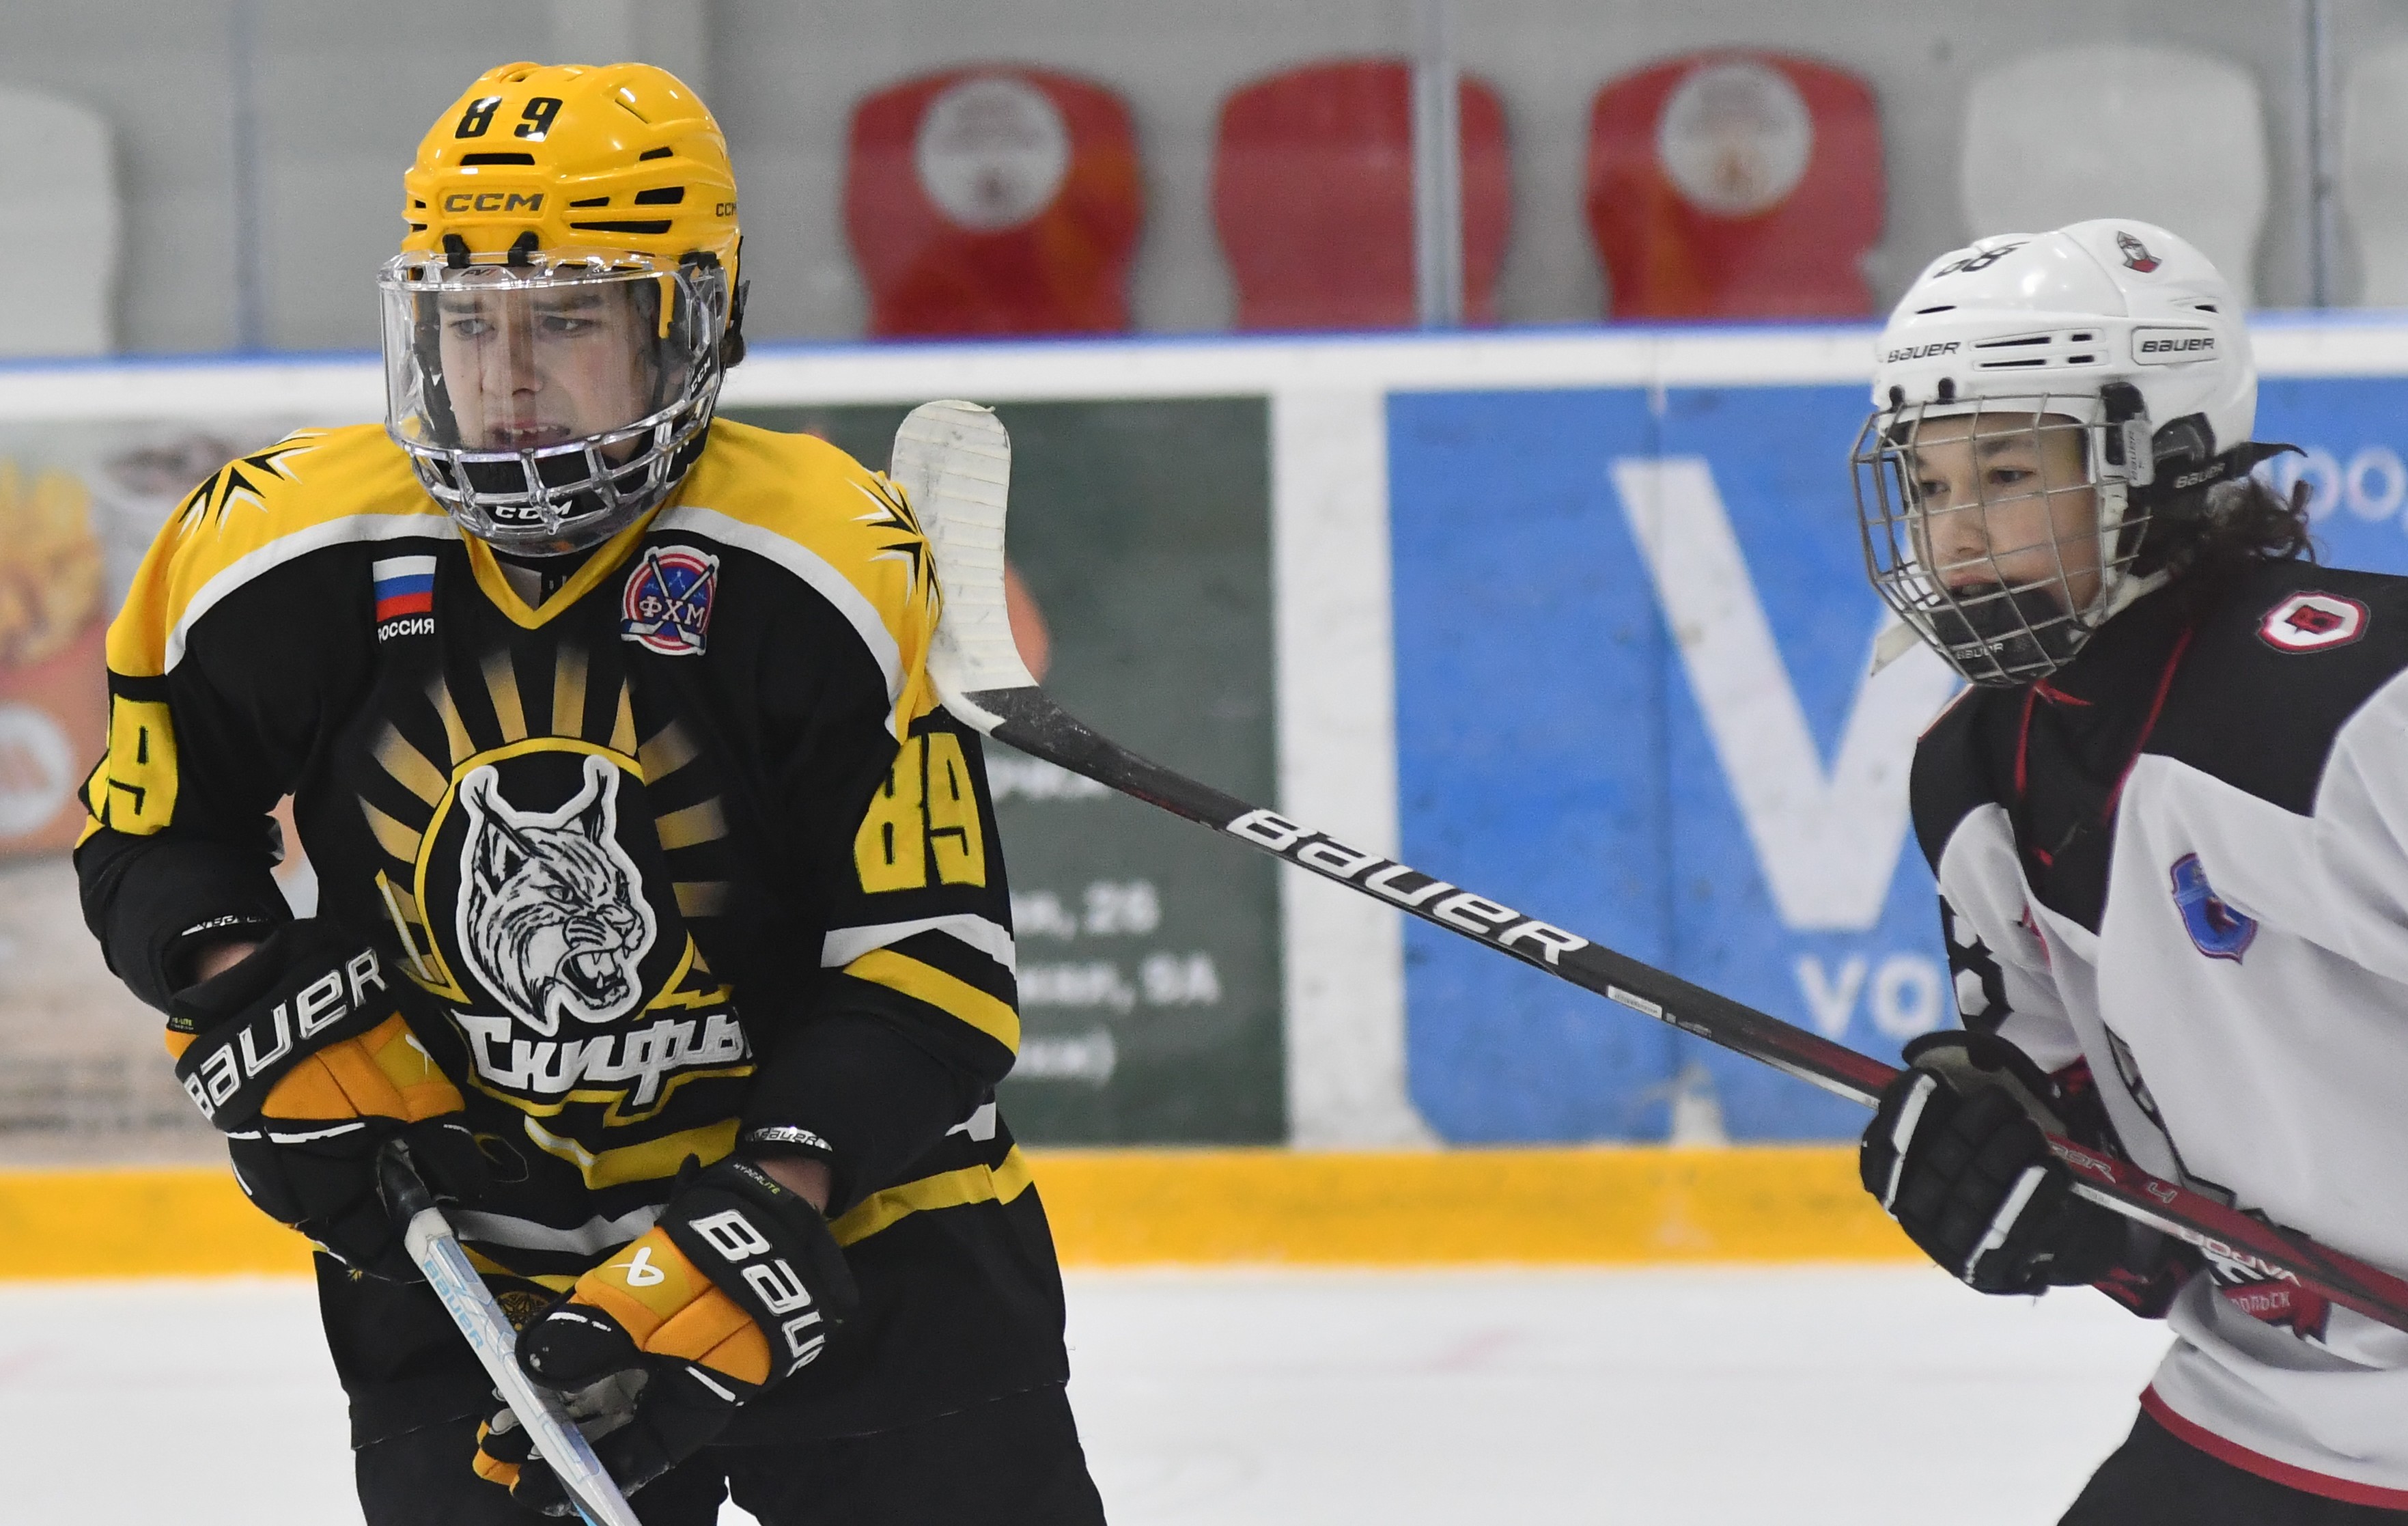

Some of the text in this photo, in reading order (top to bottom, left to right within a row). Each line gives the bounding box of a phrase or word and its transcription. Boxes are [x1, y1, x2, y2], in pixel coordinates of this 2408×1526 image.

[445, 192, 544, 212] CCM
[690, 356, 712, 393] CCM
[494, 499, 573, 521] CCM
[639, 593, 706, 626] ФХМ
[854, 732, 986, 894] 89
